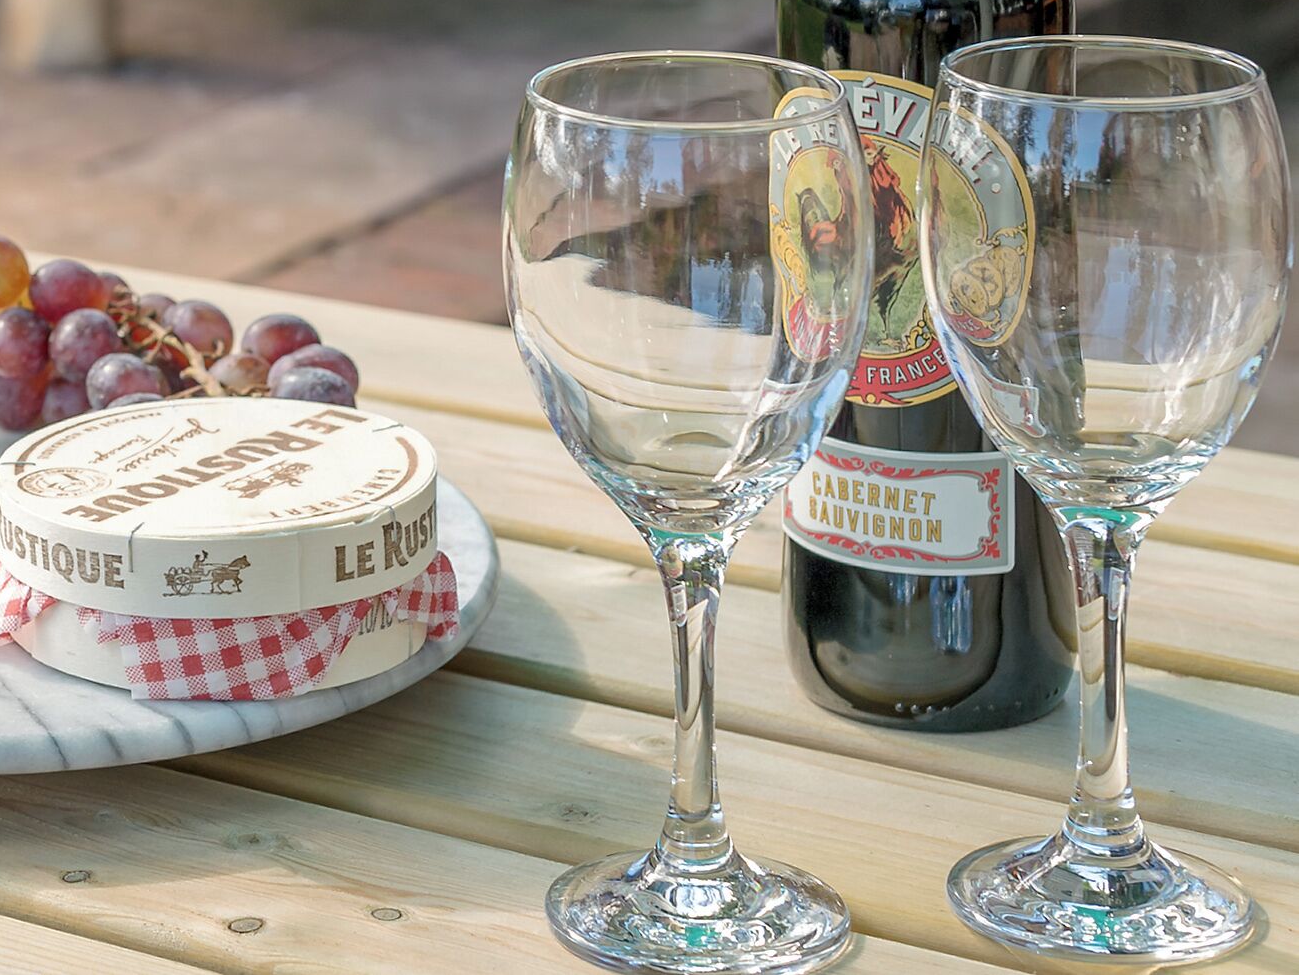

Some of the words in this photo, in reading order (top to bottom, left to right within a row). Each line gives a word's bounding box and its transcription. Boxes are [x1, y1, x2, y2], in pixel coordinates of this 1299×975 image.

[867, 346, 947, 386] FRANCE
[290, 409, 369, 434] LE
[62, 430, 324, 522] RUSTIQUE
[269, 468, 401, 518] CAMEMBERT
[812, 471, 937, 516] CABERNET
[808, 495, 943, 544] SAUVIGNON
[335, 540, 375, 583] LE
